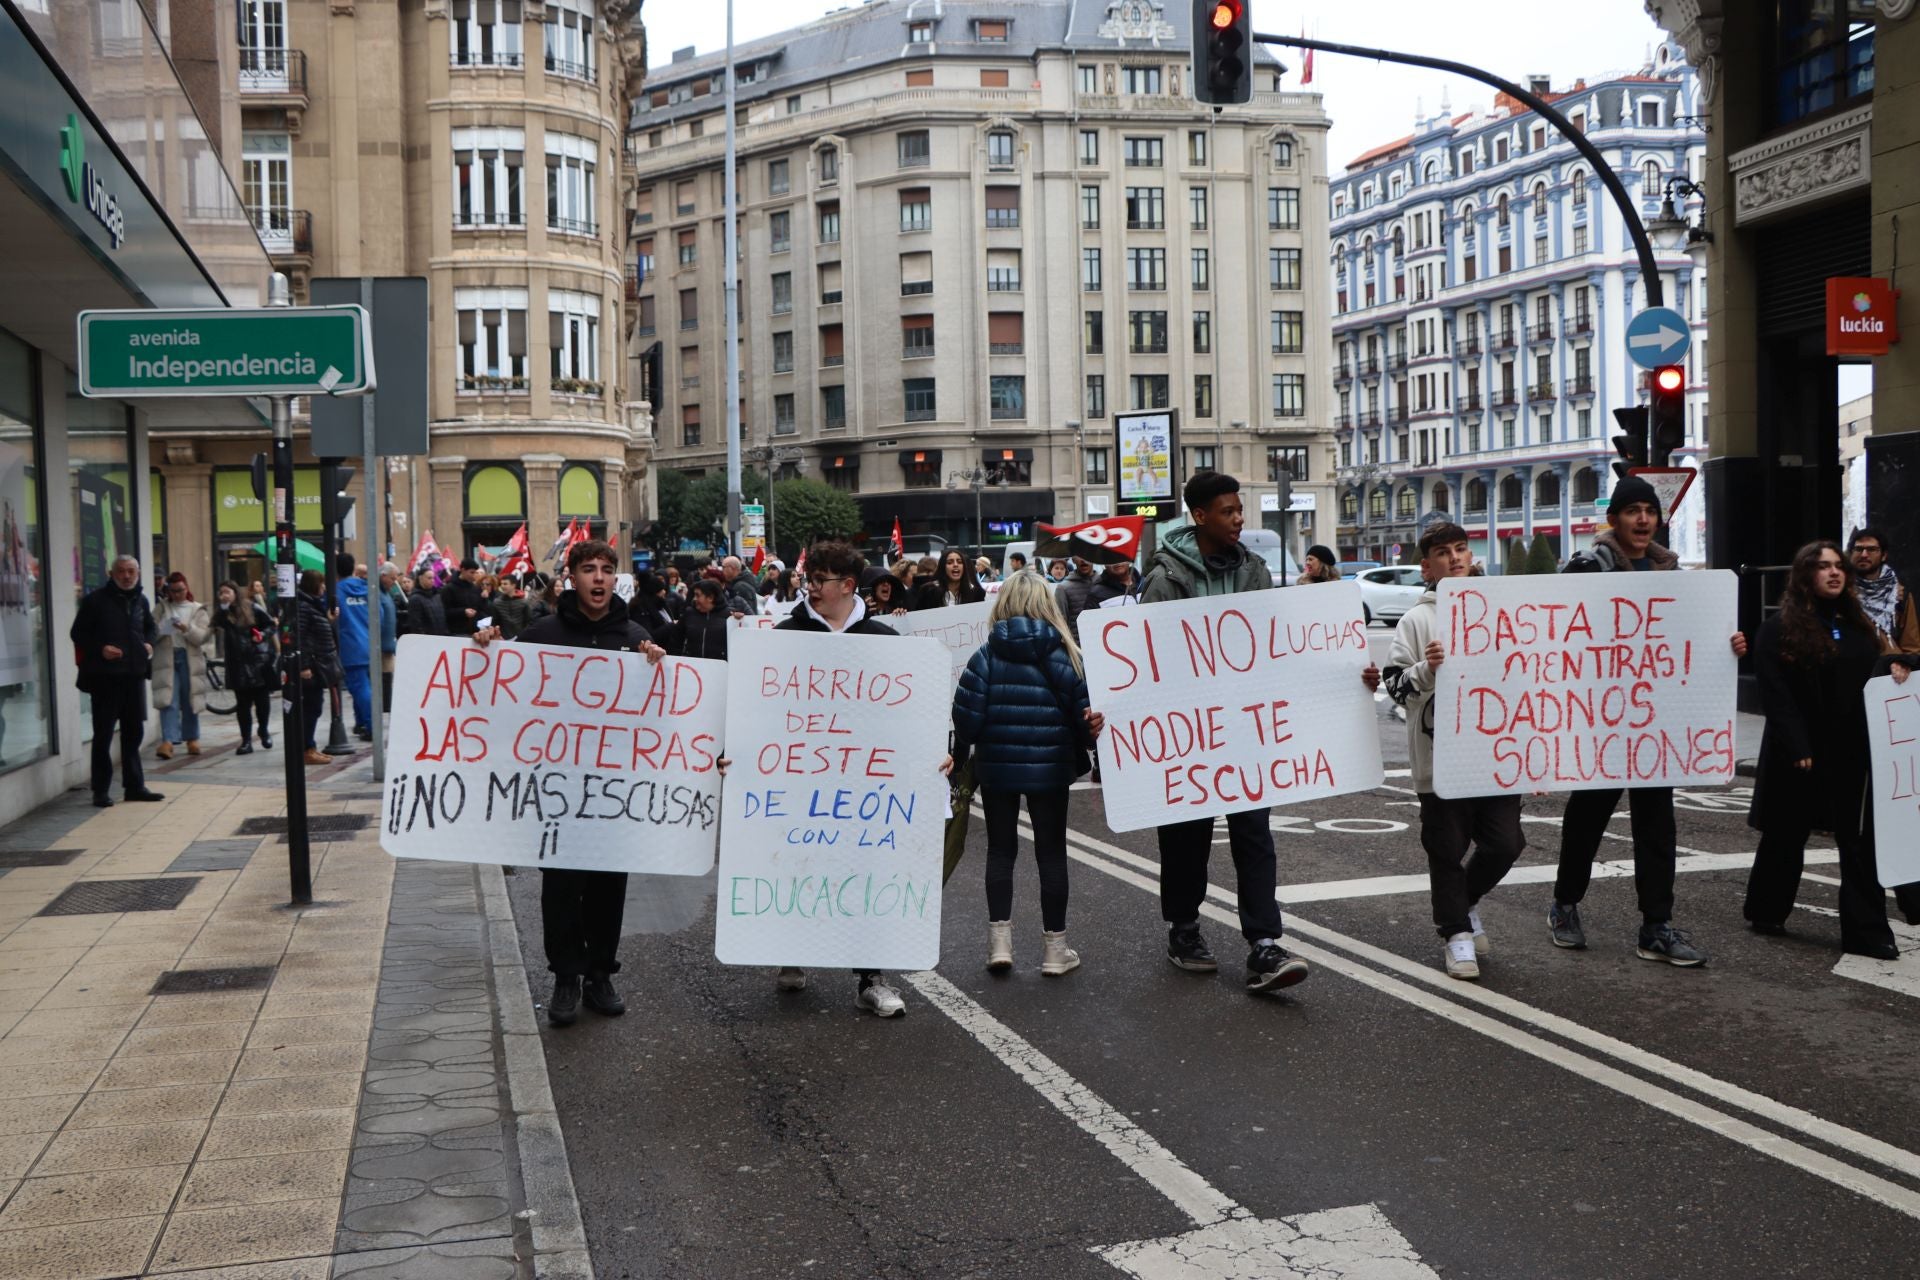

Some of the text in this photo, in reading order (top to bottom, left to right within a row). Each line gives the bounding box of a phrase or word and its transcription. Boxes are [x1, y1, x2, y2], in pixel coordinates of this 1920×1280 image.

[83, 161, 124, 249] Unicaja
[129, 329, 200, 346] avenida
[1840, 316, 1883, 332] luckia
[129, 351, 316, 383] Independencia
[239, 496, 262, 505] YVE
[1610, 597, 1676, 641] DE
[1102, 609, 1367, 690] SI NO LUCHAS
[420, 648, 703, 717] ARREGLAD
[761, 665, 913, 706] BARRIOS
[786, 710, 852, 733] DEL
[1241, 700, 1293, 746] TE
[415, 716, 715, 772] LAS GOTERAS
[758, 742, 895, 777] OESTE
[486, 763, 568, 822] MÁS
[575, 774, 715, 830] ESCUSAS
[1165, 749, 1335, 805] ESCUCHA
[744, 783, 915, 825] DE LEÓN
[787, 828, 895, 849] CON LA
[731, 873, 930, 918] EDUCACIÓN
